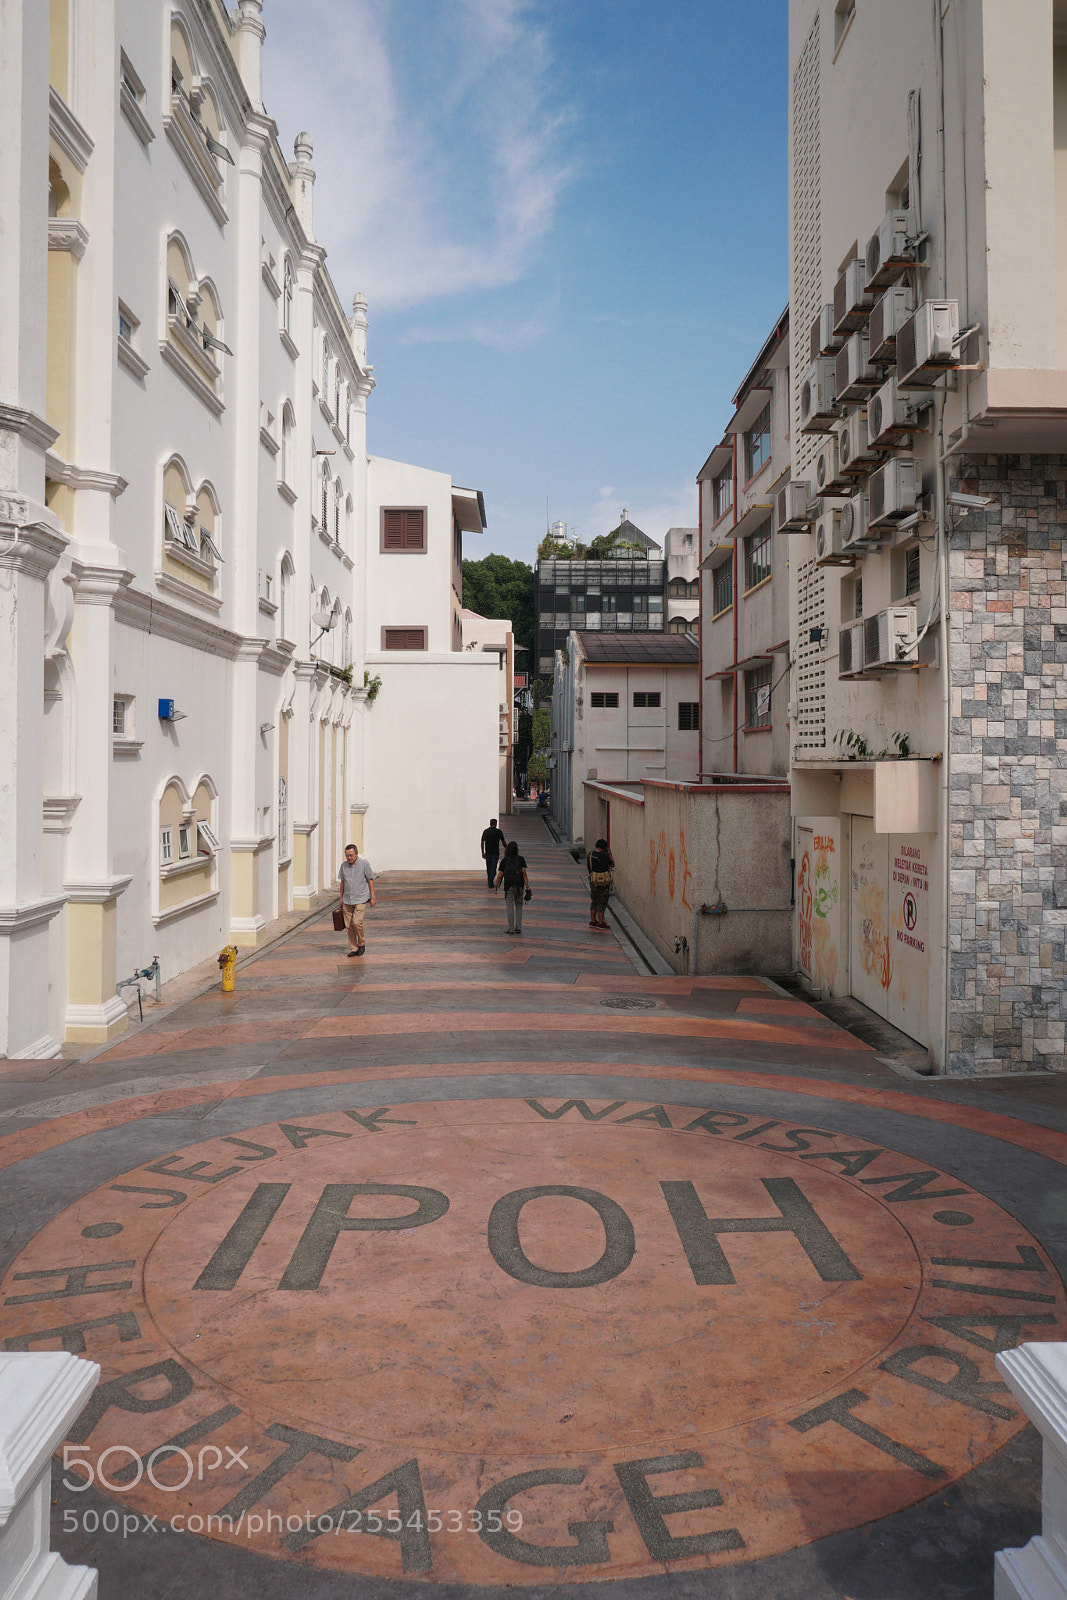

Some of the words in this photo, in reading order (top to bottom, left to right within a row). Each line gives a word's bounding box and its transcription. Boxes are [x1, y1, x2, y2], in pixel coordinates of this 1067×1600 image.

[901, 845, 920, 860] DILARANG
[896, 930, 903, 942] NO
[903, 933, 925, 953] PARKING
[108, 1107, 418, 1211] JEJAK
[524, 1098, 972, 1203] WARISAN
[191, 1176, 864, 1291] IPOH
[2, 1259, 747, 1574] HERITAGE
[786, 1245, 1060, 1479] TRAIL
